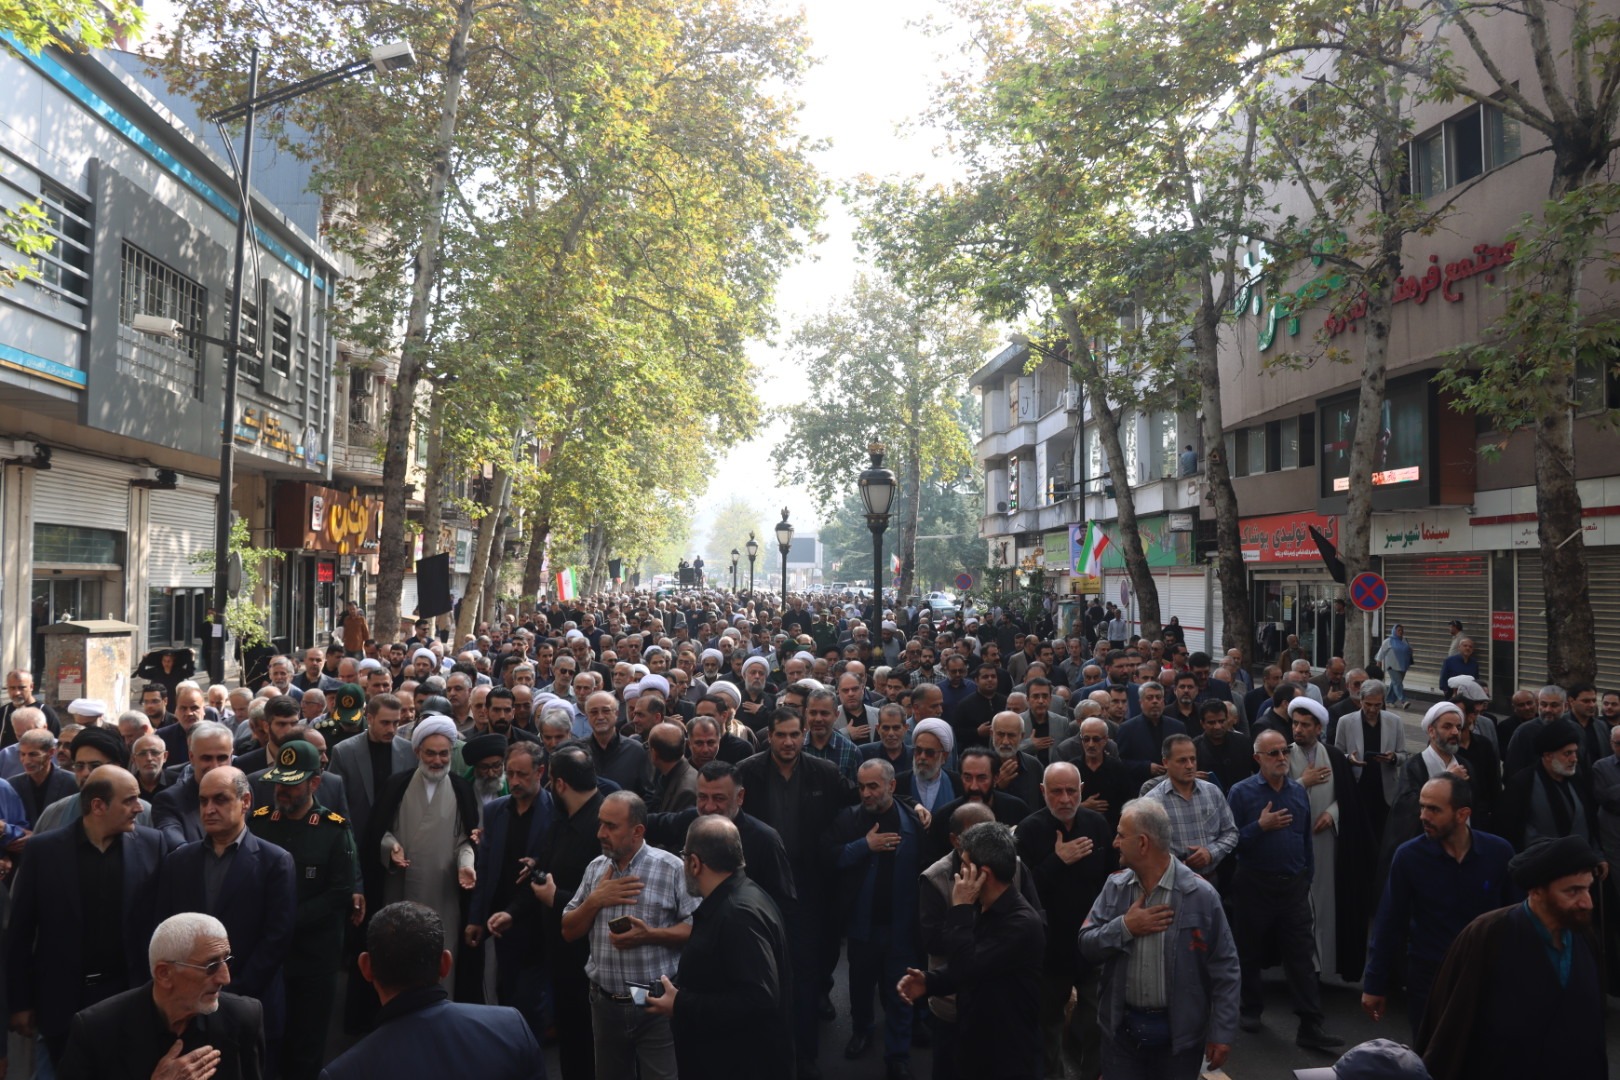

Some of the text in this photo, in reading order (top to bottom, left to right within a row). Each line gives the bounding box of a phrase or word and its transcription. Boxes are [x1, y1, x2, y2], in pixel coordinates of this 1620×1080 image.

[330, 485, 369, 555] نوشین
[1240, 515, 1335, 552] گو تولیدی پوشاک
[1384, 521, 1450, 548] سینما شهر سبز
